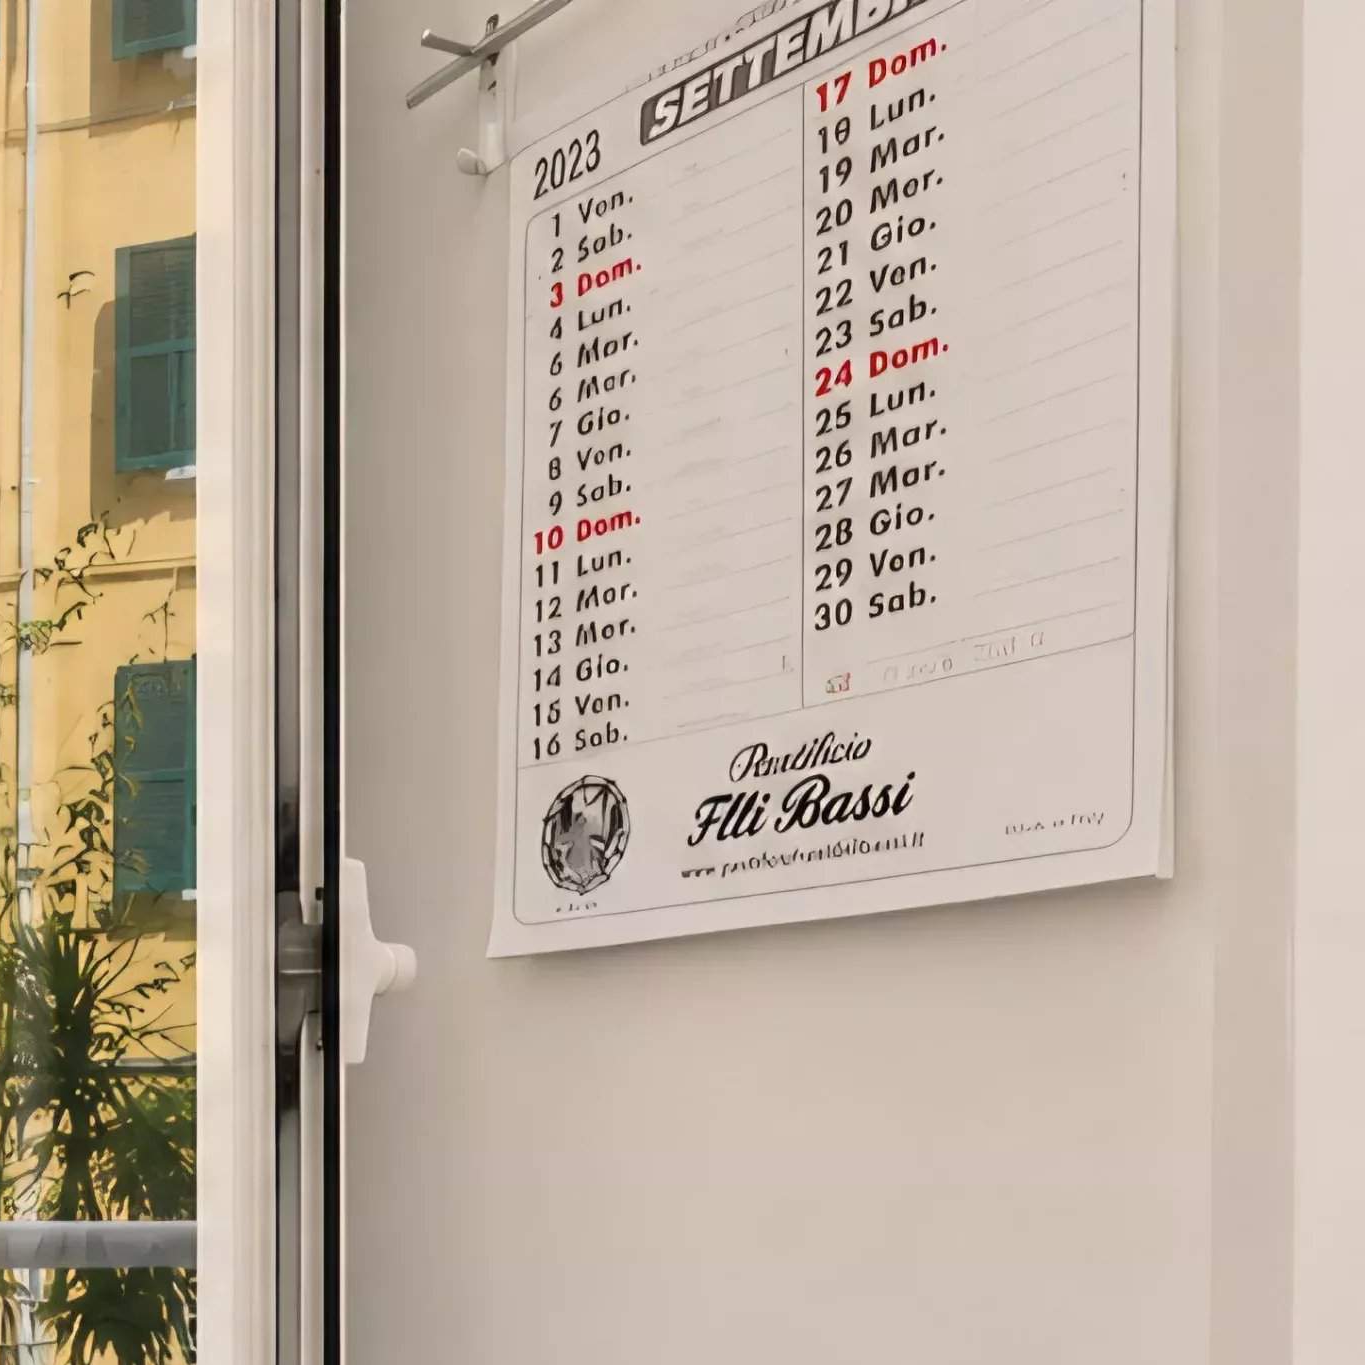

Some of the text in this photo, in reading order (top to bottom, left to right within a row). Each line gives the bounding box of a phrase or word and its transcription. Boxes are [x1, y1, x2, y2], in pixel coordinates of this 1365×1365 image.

[647, 0, 924, 140] SETTEMB
[815, 37, 947, 113] 17 Dom.
[870, 87, 936, 131] Lun.
[533, 129, 602, 199] 2023
[819, 125, 945, 194] 19 Mar.
[551, 211, 562, 238] 1
[815, 198, 853, 237] 20
[551, 247, 565, 274] 2
[817, 214, 937, 276] 21 Gio.
[549, 257, 642, 309] 3 Dom.
[815, 278, 854, 317] 22
[577, 298, 631, 332] Lun.
[815, 293, 937, 358] 23 Sab.
[814, 336, 949, 398] 24 Dom.
[548, 386, 563, 412] 6
[815, 381, 936, 438] 25 Lun.
[549, 419, 563, 449] 7
[815, 419, 947, 475] 26 Mar.
[548, 455, 562, 481] 8
[548, 490, 563, 517] 9
[815, 476, 853, 513] 27
[533, 510, 641, 556] 10 Dom.
[814, 502, 935, 553] 28 Gio.
[535, 549, 632, 588] 11 Lun.
[814, 557, 853, 593] 29
[535, 595, 563, 624] 12
[814, 580, 937, 632] 30 Sab.
[534, 629, 562, 658] 13
[533, 664, 562, 693] 14
[533, 731, 561, 761] 16
[774, 771, 915, 833] Bassi
